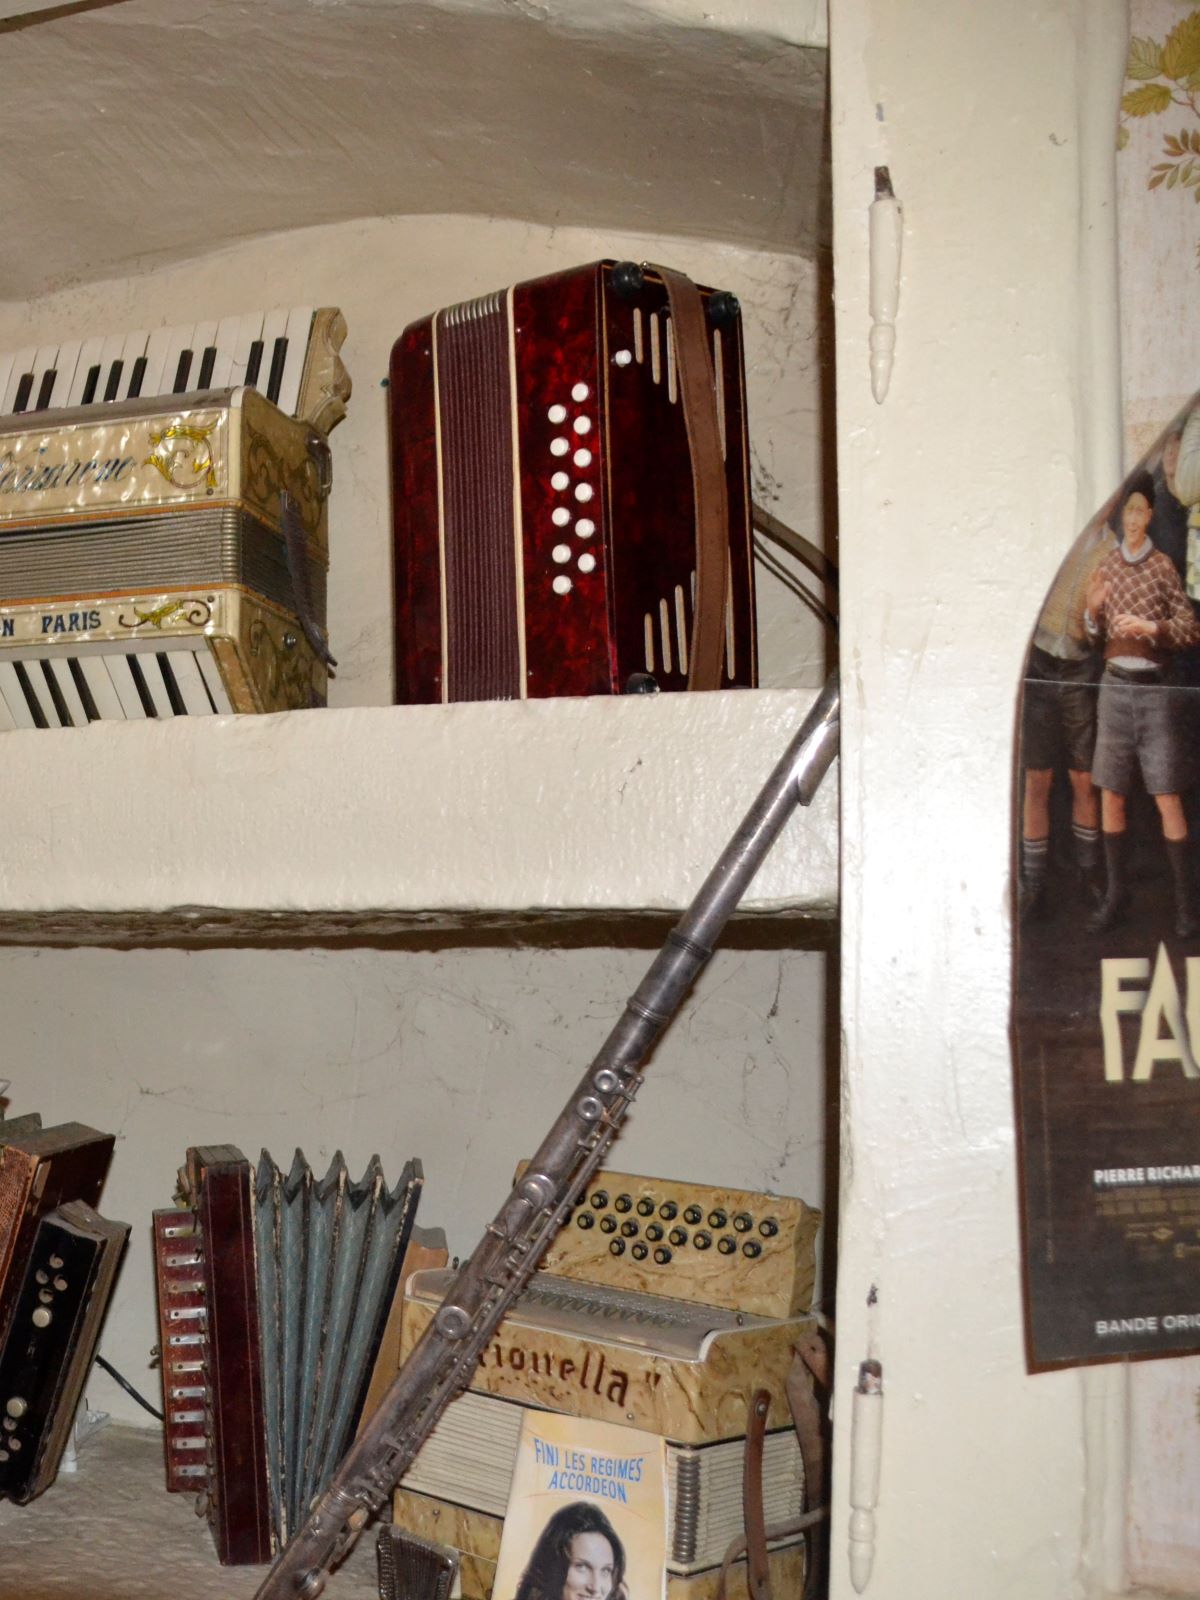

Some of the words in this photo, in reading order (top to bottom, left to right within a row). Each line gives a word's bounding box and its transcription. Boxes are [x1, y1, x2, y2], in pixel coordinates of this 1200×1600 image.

[41, 610, 102, 633] PARIS
[1093, 1167, 1145, 1184] PIERRE
[1095, 1316, 1158, 1335] BANDE
[533, 1438, 559, 1466] FINI
[565, 1450, 586, 1472] LES
[590, 1456, 644, 1482] REGIMES
[548, 1471, 628, 1504] ACCORDEON
